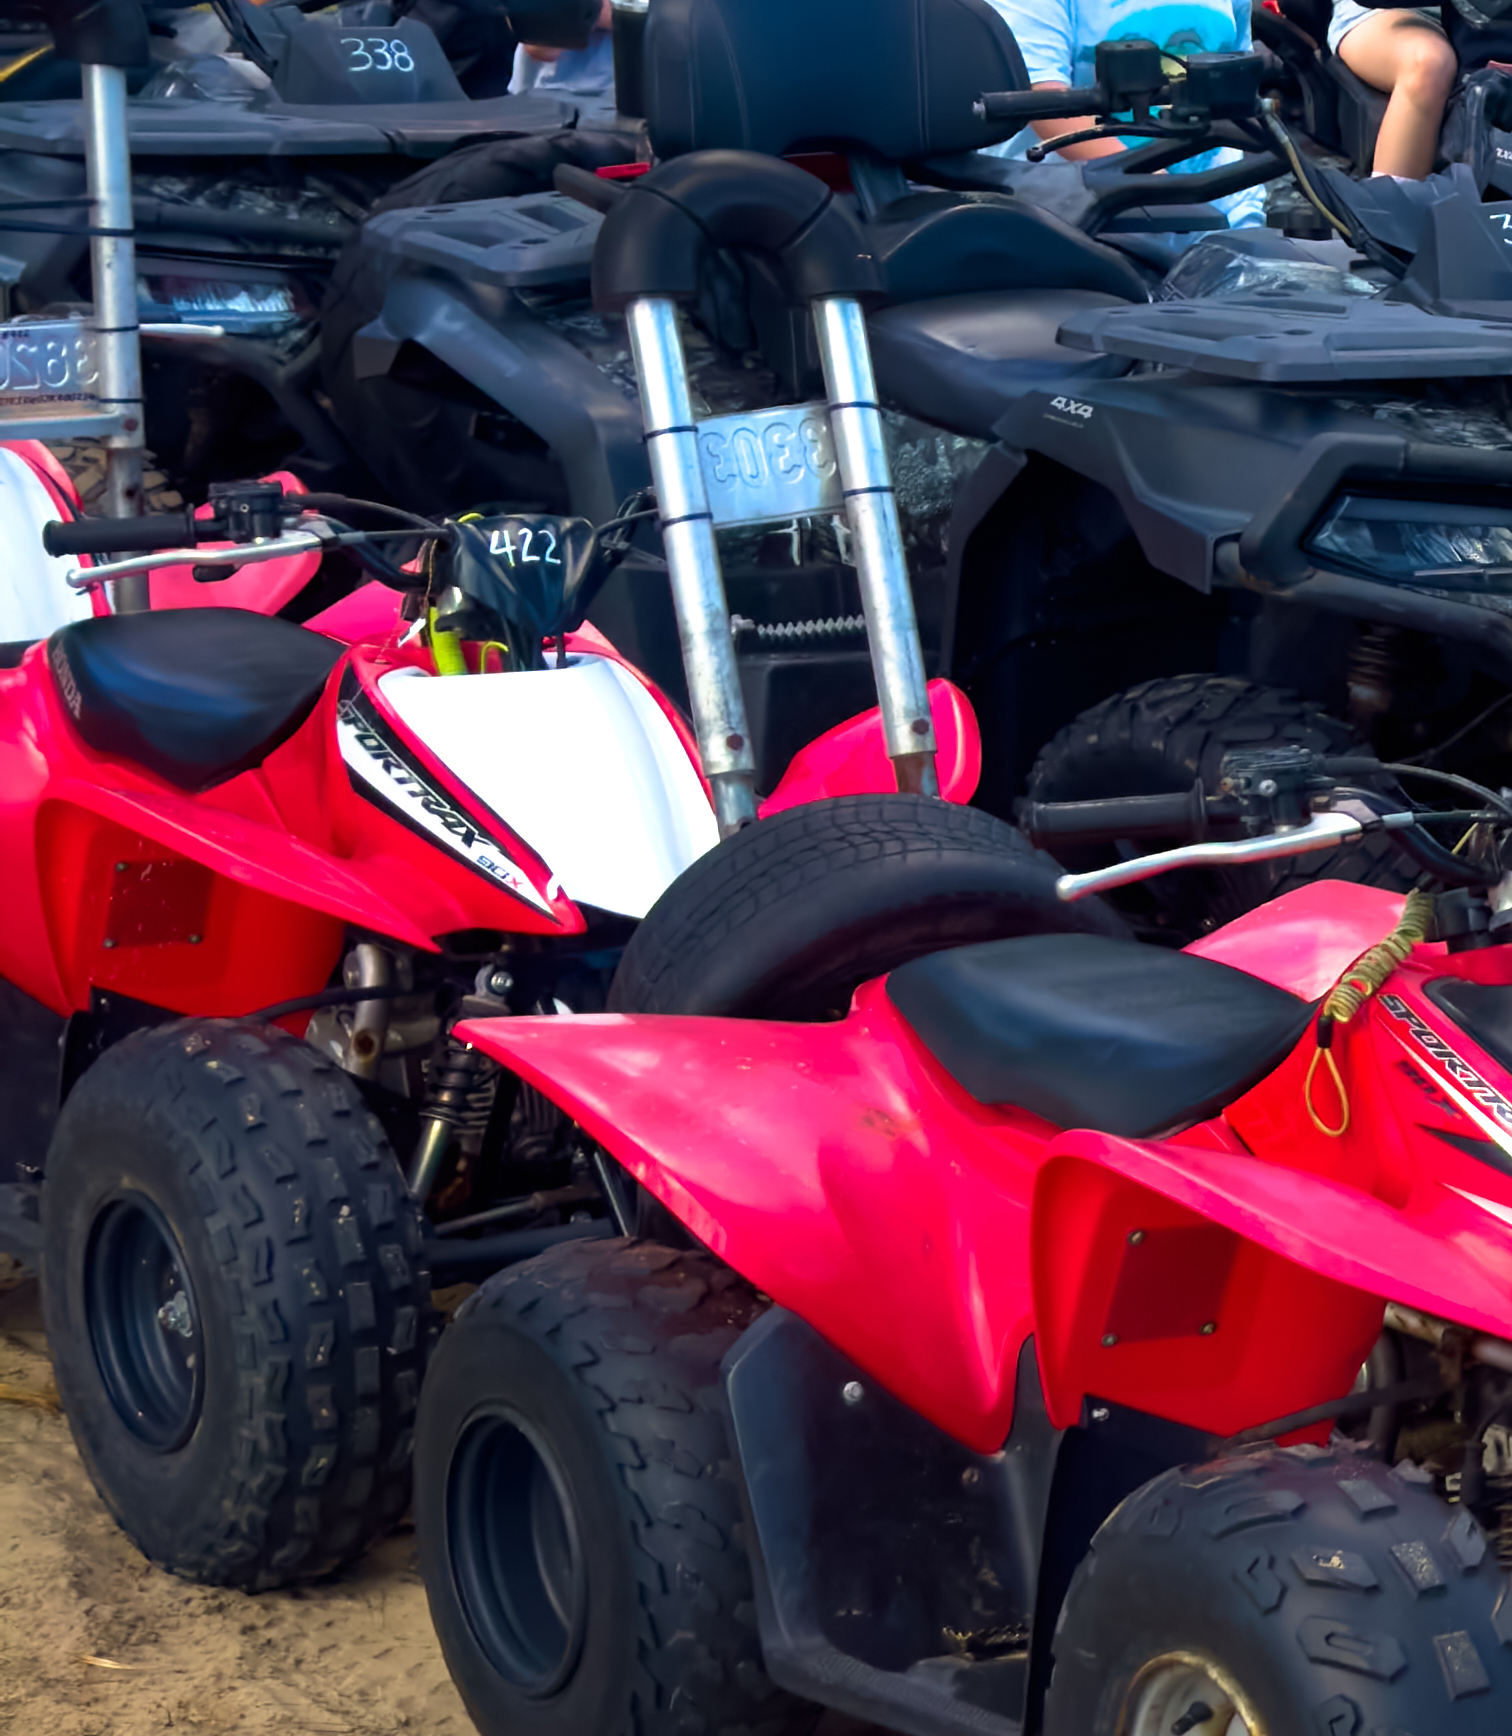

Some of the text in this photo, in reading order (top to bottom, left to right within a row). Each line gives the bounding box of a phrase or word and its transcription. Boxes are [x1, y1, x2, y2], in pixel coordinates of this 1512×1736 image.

[340, 38, 415, 72] 338
[1050, 396, 1094, 418] 4X4
[489, 527, 562, 567] 422
